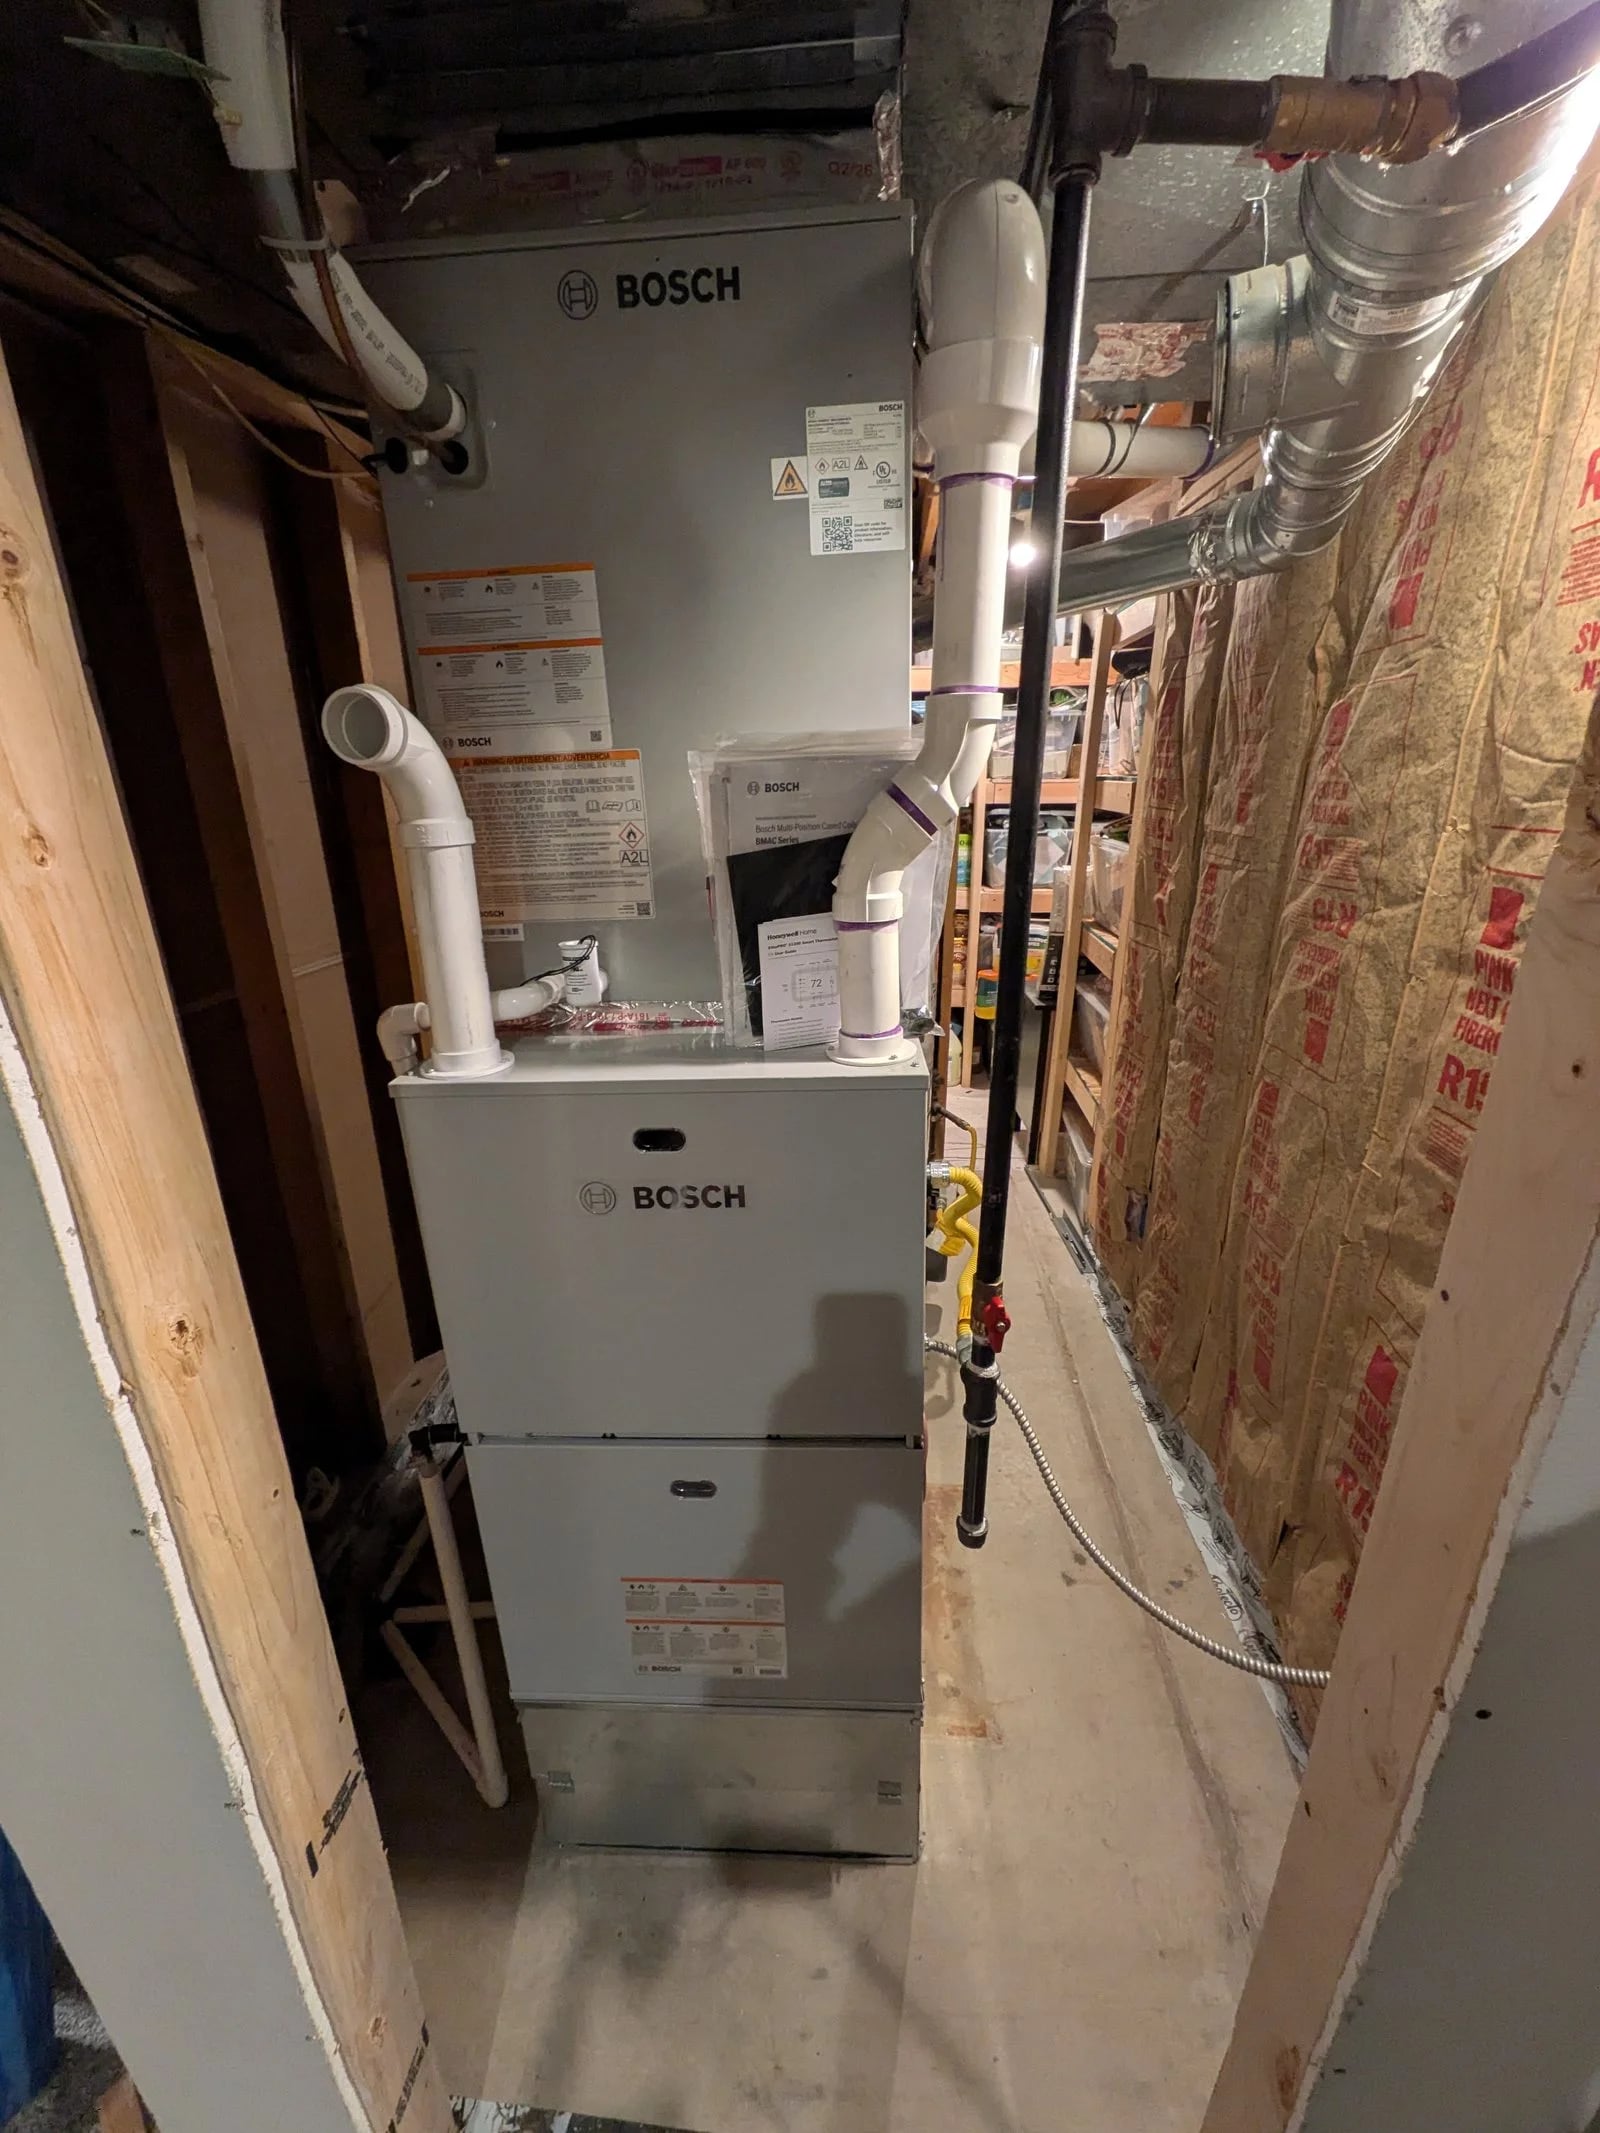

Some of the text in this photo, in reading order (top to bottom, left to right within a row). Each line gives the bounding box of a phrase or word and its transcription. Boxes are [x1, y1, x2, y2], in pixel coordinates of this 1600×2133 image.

[616, 266, 740, 308] BOSCH
[878, 403, 903, 412] BOSCH
[833, 459, 849, 469] A2L
[458, 737, 492, 747] BOSCH
[764, 782, 800, 793] BOSCH
[755, 824, 776, 833] Bosch
[776, 823, 820, 832] Multi-Position
[755, 836, 799, 846] BMAC Series
[621, 851, 648, 864] A2L
[767, 928, 817, 941] Honeywell Home
[1474, 949, 1517, 995] PINK
[810, 979, 822, 988] 72
[633, 1185, 746, 1209] BOSCH
